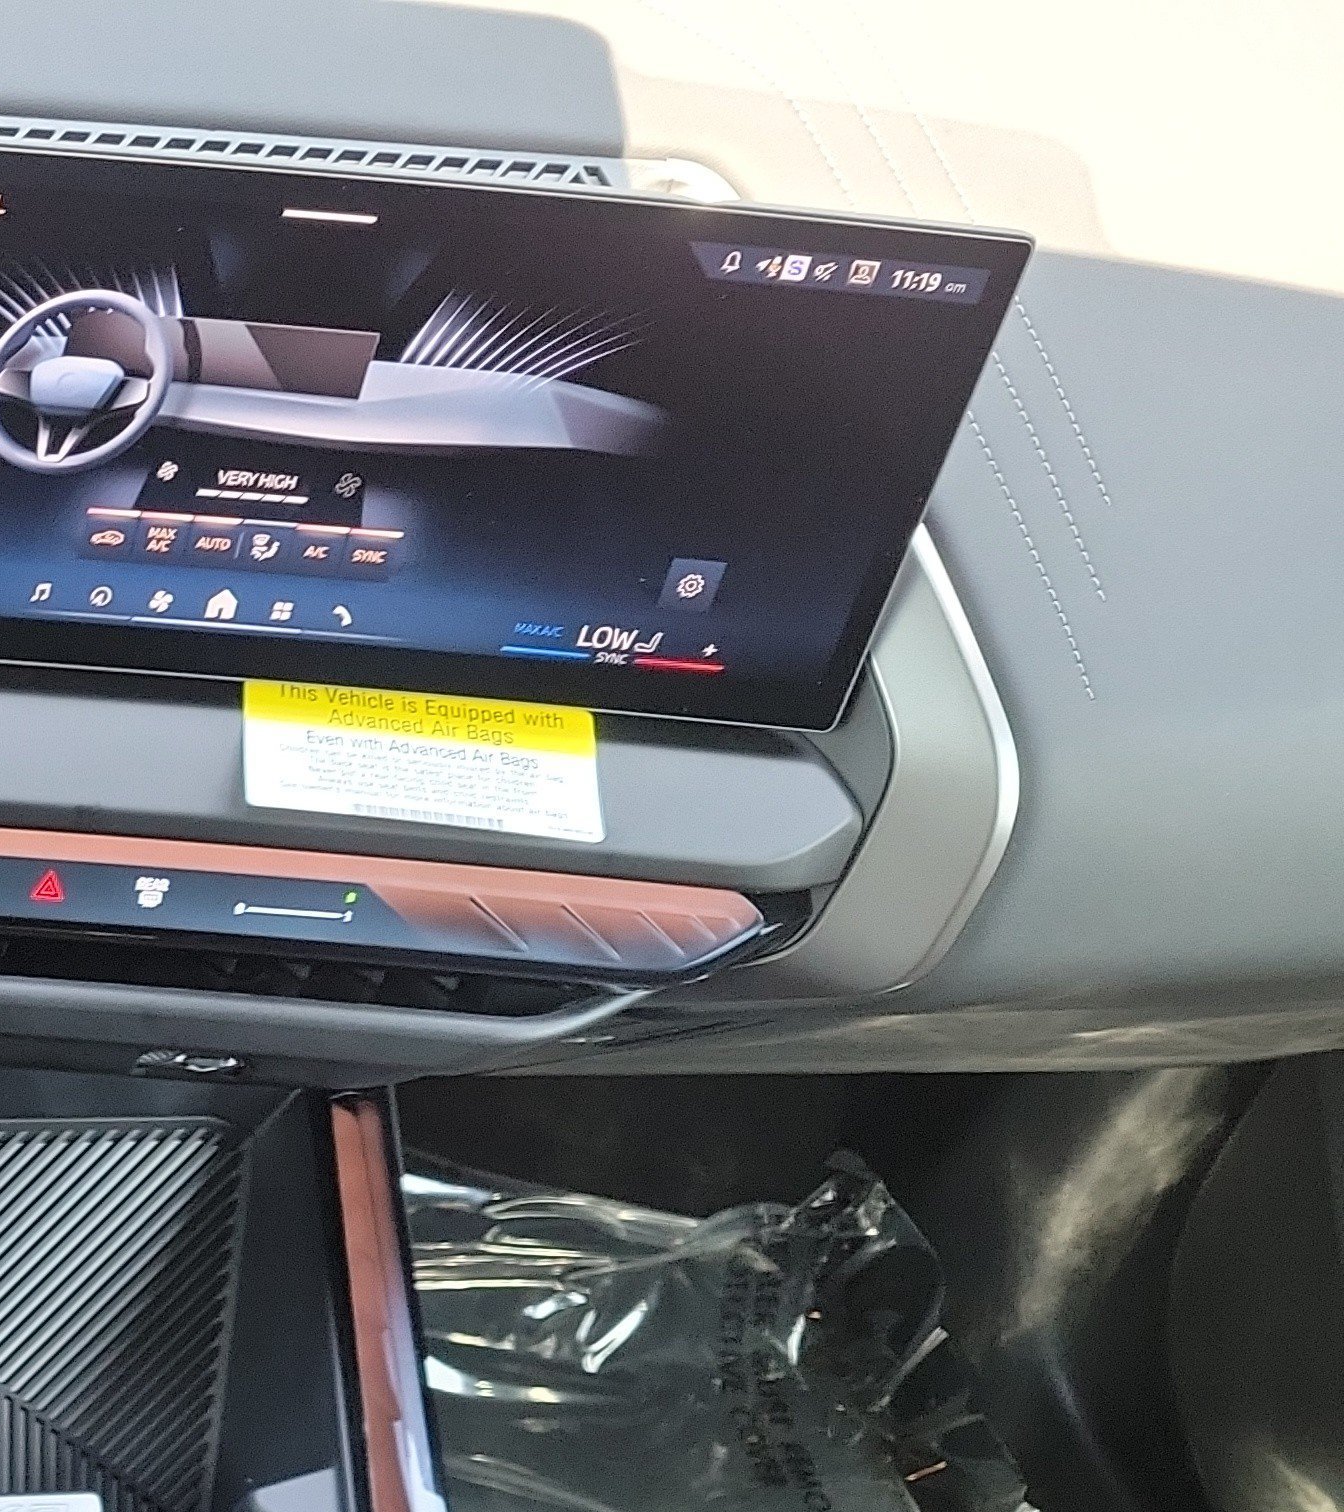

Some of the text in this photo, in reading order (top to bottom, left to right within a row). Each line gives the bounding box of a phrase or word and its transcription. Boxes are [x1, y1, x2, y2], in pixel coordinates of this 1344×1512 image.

[891, 268, 943, 293] 11:19
[217, 469, 299, 490] VERY HIGH
[147, 527, 176, 540] MAX
[146, 539, 171, 552] A/C
[195, 536, 232, 551] AUTO
[303, 545, 330, 559] A/C
[351, 549, 388, 564] SYNC
[575, 624, 638, 650] LOW
[593, 651, 631, 665] SYNC
[279, 683, 565, 730] This Vehicle is Equipped with
[328, 709, 515, 747] Advanced Air Bags
[306, 730, 540, 771] Even with Advanced Air Bags
